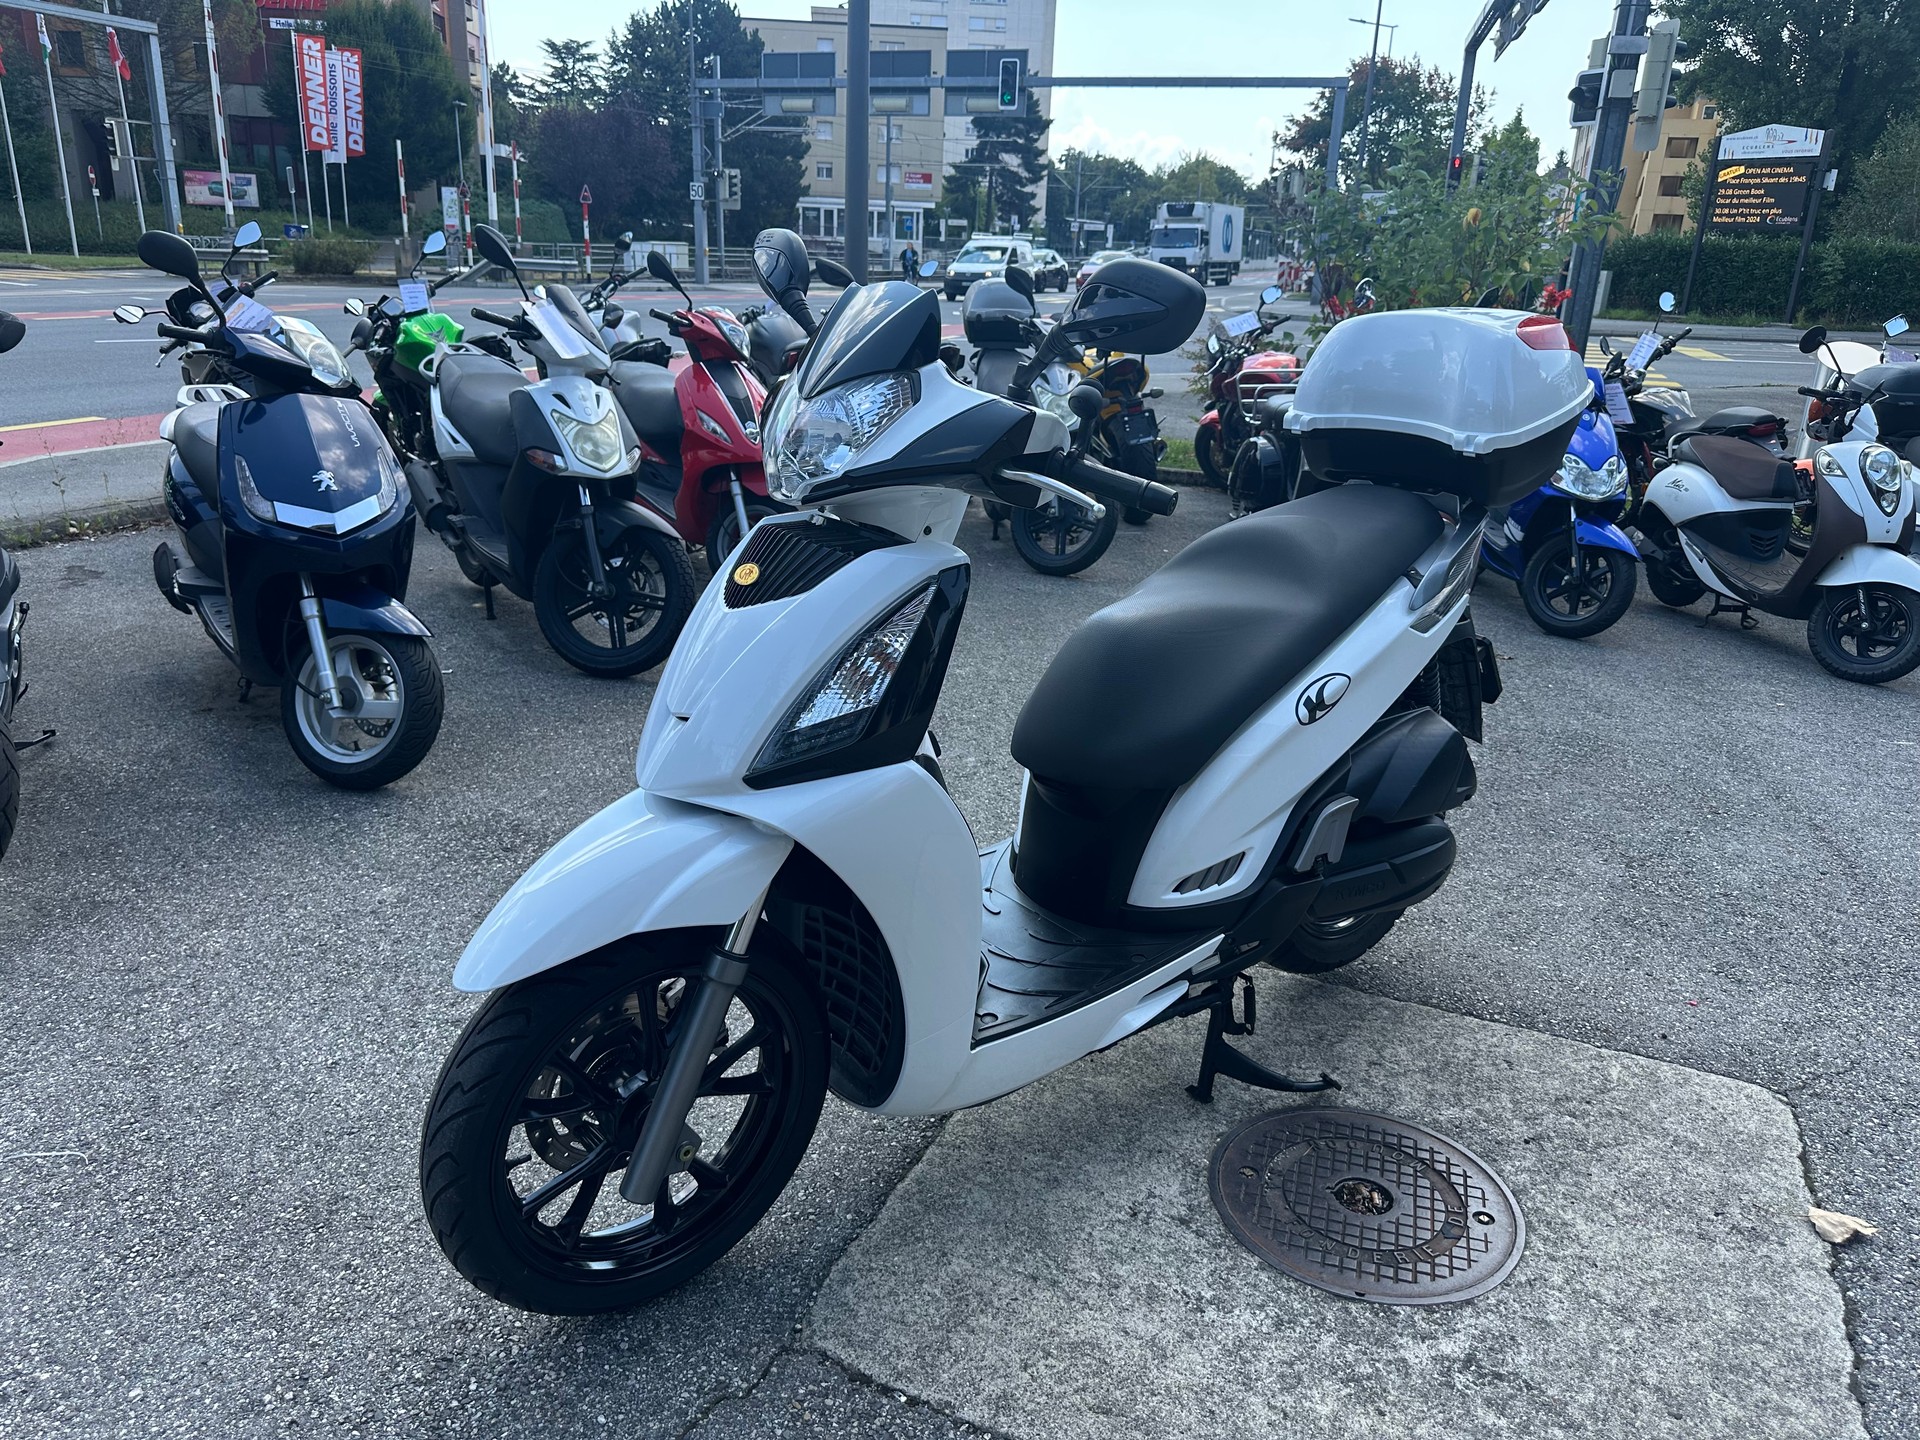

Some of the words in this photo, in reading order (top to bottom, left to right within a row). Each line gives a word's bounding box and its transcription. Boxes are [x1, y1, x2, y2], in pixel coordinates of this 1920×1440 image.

[302, 38, 329, 146] DENNER
[328, 63, 338, 116] boissons
[342, 52, 364, 153] DENNER
[691, 184, 704, 198] 50
[1733, 188, 1750, 196] Green
[1770, 207, 1782, 215] plus
[1289, 1219, 1440, 1265] FONDERIE
